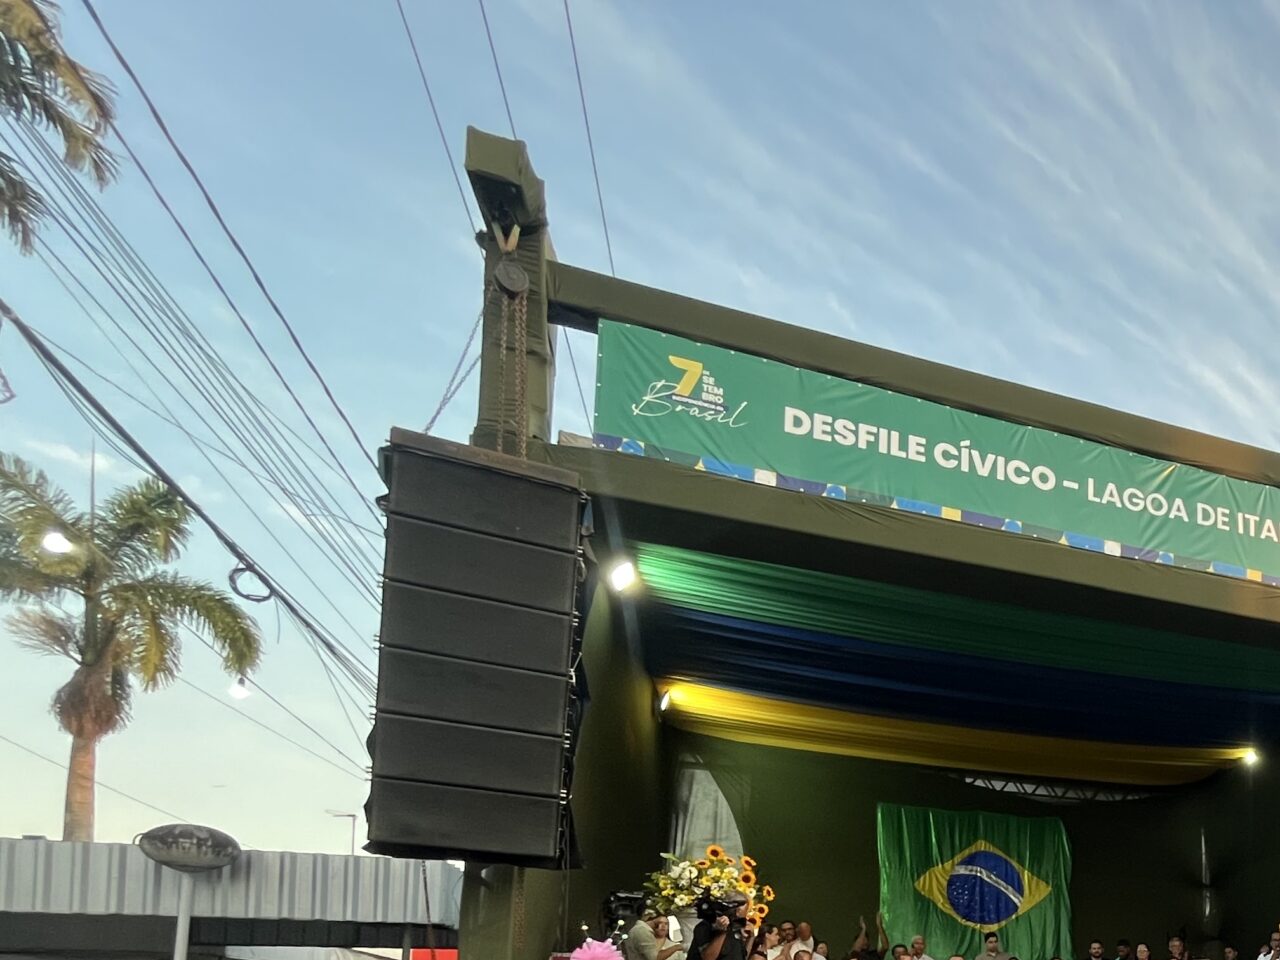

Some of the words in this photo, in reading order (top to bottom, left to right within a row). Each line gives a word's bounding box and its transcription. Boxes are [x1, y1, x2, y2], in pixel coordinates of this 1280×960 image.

[668, 355, 703, 397] 7
[702, 383, 724, 395] TEM
[632, 380, 748, 428] Brasil
[702, 392, 724, 404] BRO
[784, 406, 926, 463] DESFILE
[933, 439, 1056, 491] CÍVICO
[1087, 478, 1189, 522] LAGOA
[1197, 503, 1230, 531] DE
